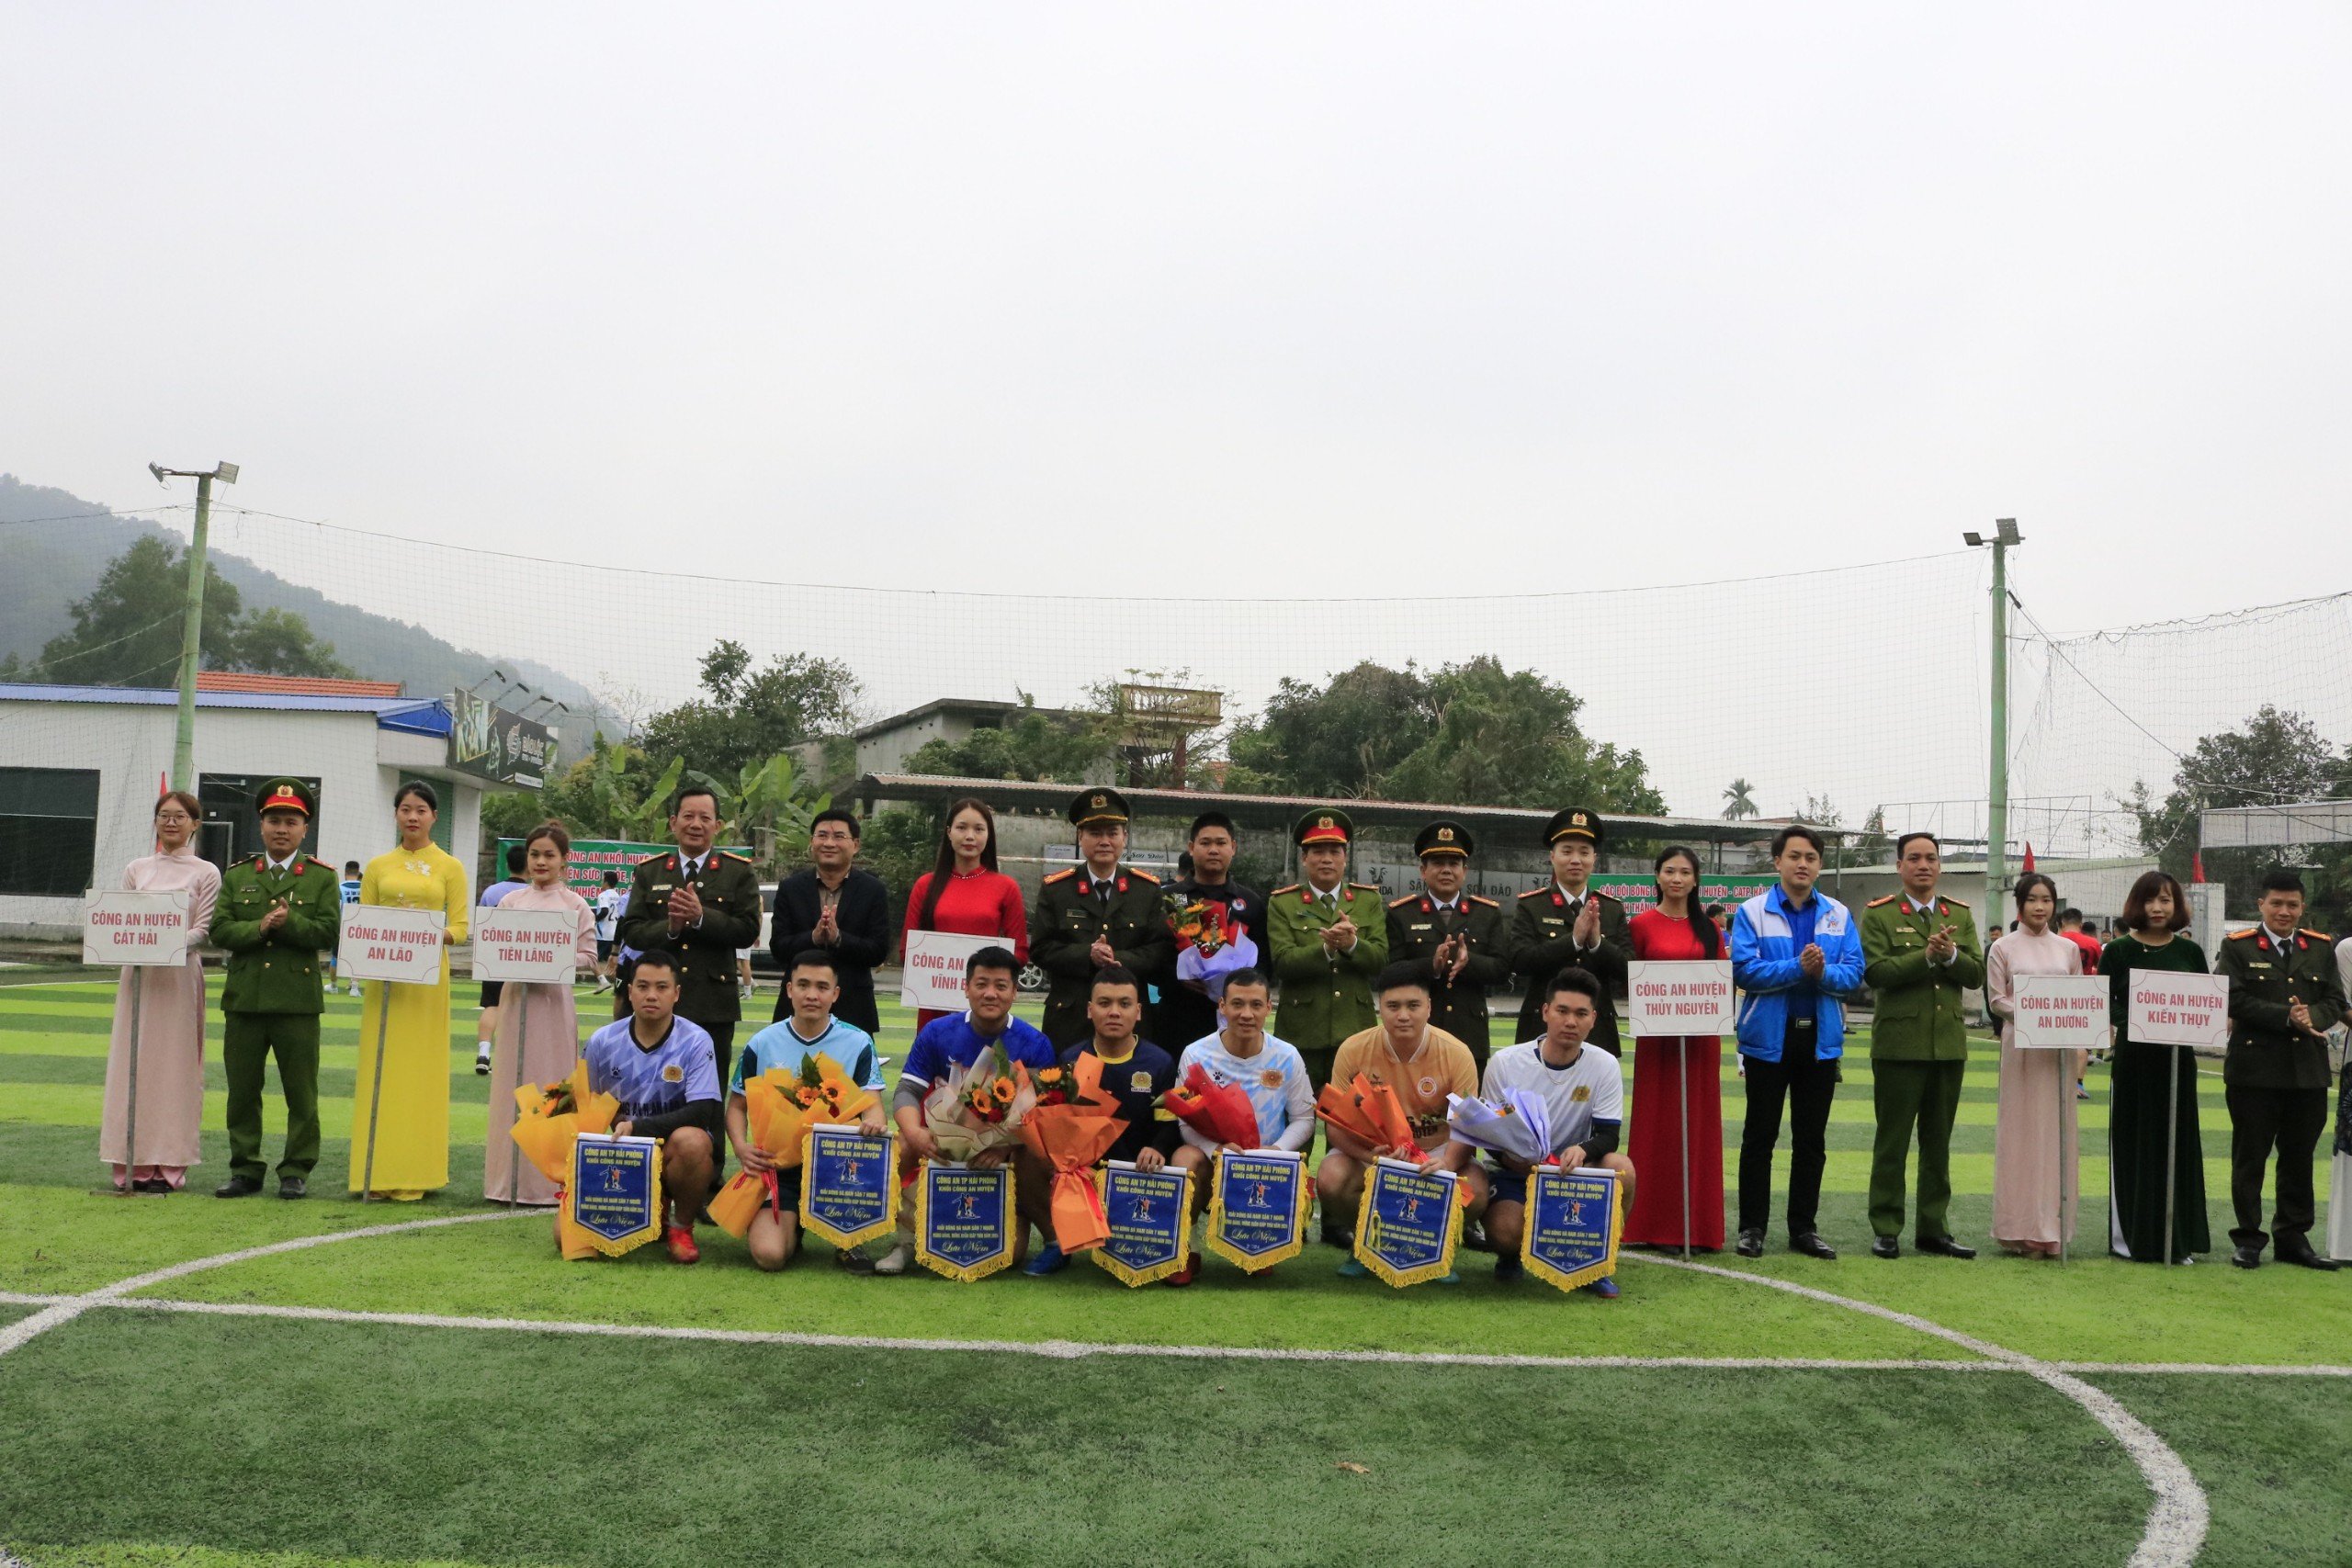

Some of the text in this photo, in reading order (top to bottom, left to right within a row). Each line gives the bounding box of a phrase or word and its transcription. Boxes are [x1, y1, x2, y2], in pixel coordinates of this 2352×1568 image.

[567, 849, 584, 862] ÔNG
[588, 852, 600, 863] AN
[603, 850, 624, 863] KHỐI
[582, 867, 600, 880] SỨC
[1600, 884, 1615, 897] CÁC
[1616, 884, 1628, 898] ĐỘI
[1630, 884, 1650, 897] BÓNG
[1703, 885, 1727, 899] HUYỆN
[1724, 903, 1738, 914] TRU
[92, 910, 181, 929] CÔNG AN HUYỆN
[114, 929, 157, 944] CÁT HẢI
[348, 925, 436, 947] CÔNG AN HUYỆN
[481, 927, 571, 947] CÔNG AN HUYỆN
[368, 947, 413, 962] AN LÃO
[499, 947, 552, 963] TIÊN LÃNG
[912, 953, 964, 970] CÔNG AN
[932, 974, 957, 990] VĨNH
[1636, 981, 1726, 998] CÔNG AN HUYỆN
[1645, 999, 1718, 1015] THỦY NGUYÊN
[2021, 995, 2103, 1012] CÔNG AN HUYỆN
[2137, 989, 2222, 1010] CÔNG AN HUYỆN
[2038, 1015, 2088, 1028] AN DƯƠNG
[2148, 1009, 2210, 1028] KIẾN THỤY
